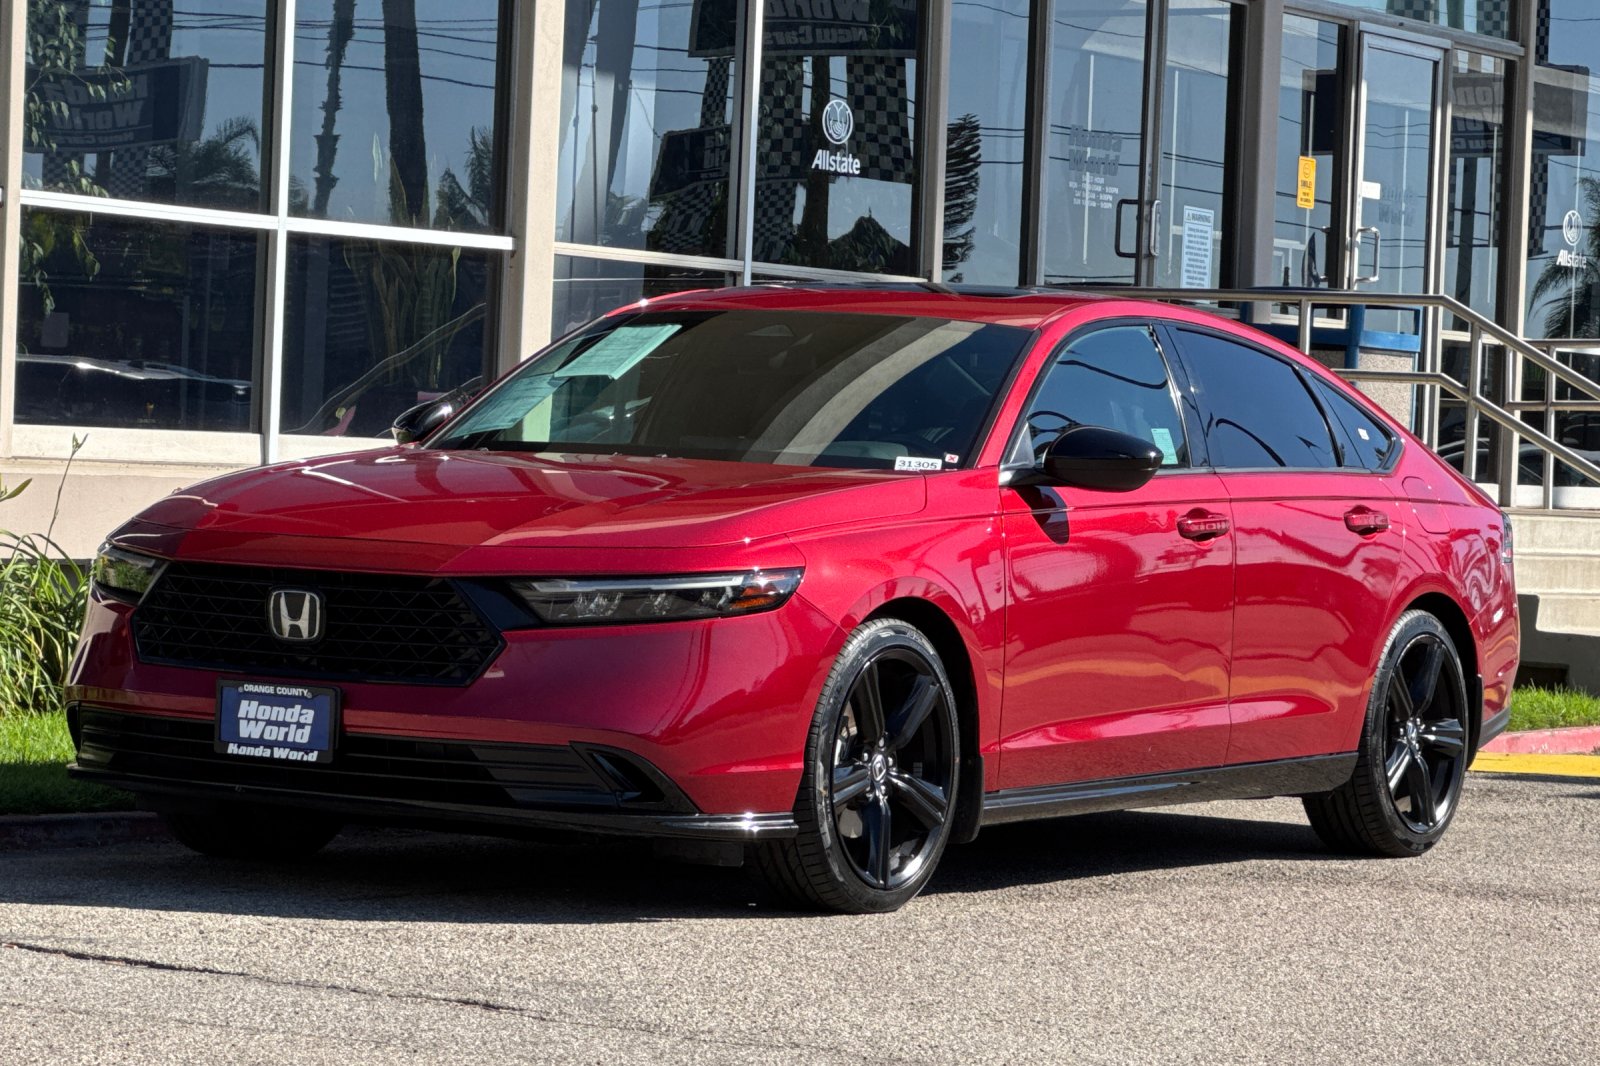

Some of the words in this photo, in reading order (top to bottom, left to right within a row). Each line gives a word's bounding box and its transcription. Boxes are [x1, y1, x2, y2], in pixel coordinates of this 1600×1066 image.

[811, 149, 861, 175] Allstate
[1556, 249, 1587, 269] Allstate
[898, 459, 939, 469] 31305
[243, 684, 275, 694] ORANGE
[276, 686, 309, 697] COUNTY
[238, 700, 315, 724] Honda
[239, 719, 312, 744] World
[227, 743, 271, 758] Honda
